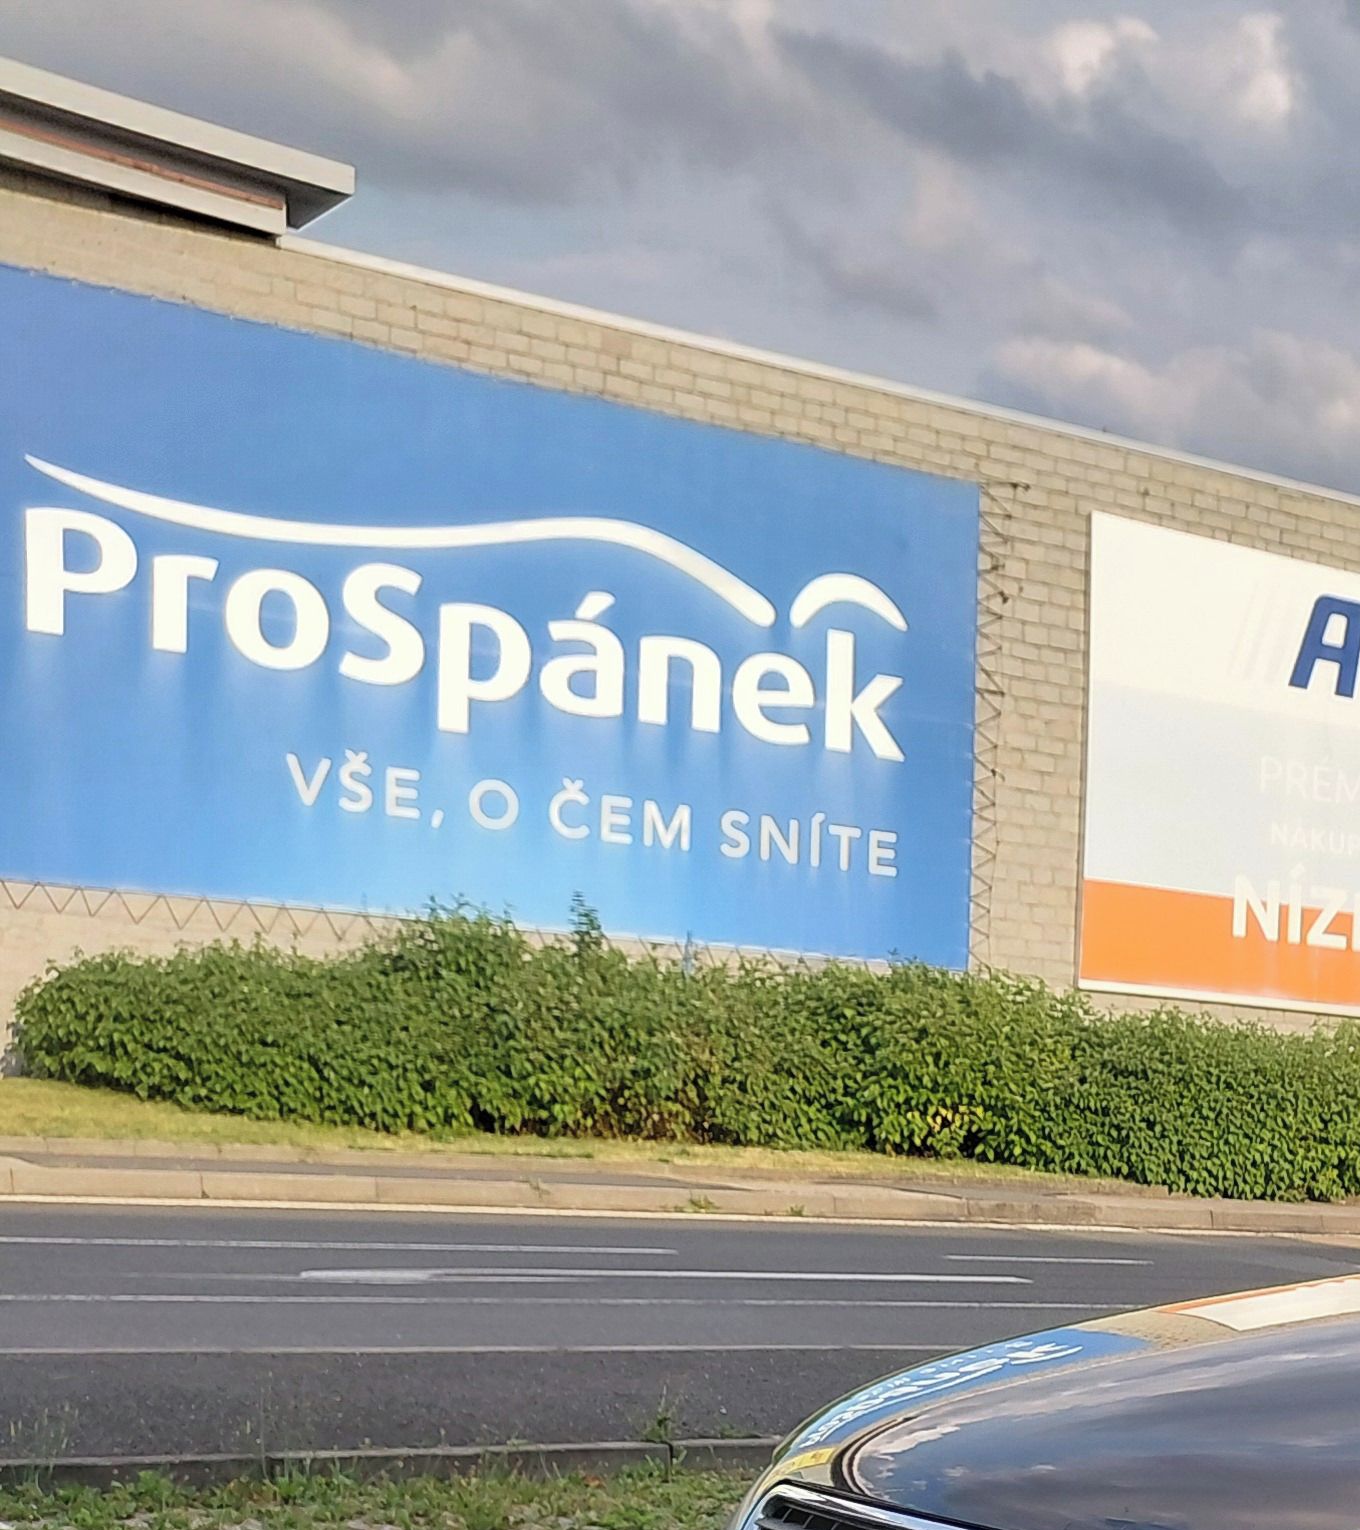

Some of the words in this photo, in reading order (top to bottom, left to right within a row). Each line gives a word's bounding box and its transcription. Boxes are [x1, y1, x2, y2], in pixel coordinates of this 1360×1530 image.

[25, 507, 906, 762] ProSpánek
[286, 750, 444, 828] VŠE,
[468, 779, 520, 831] O
[548, 777, 692, 853] ČEM
[718, 809, 900, 878] SNÍTE
